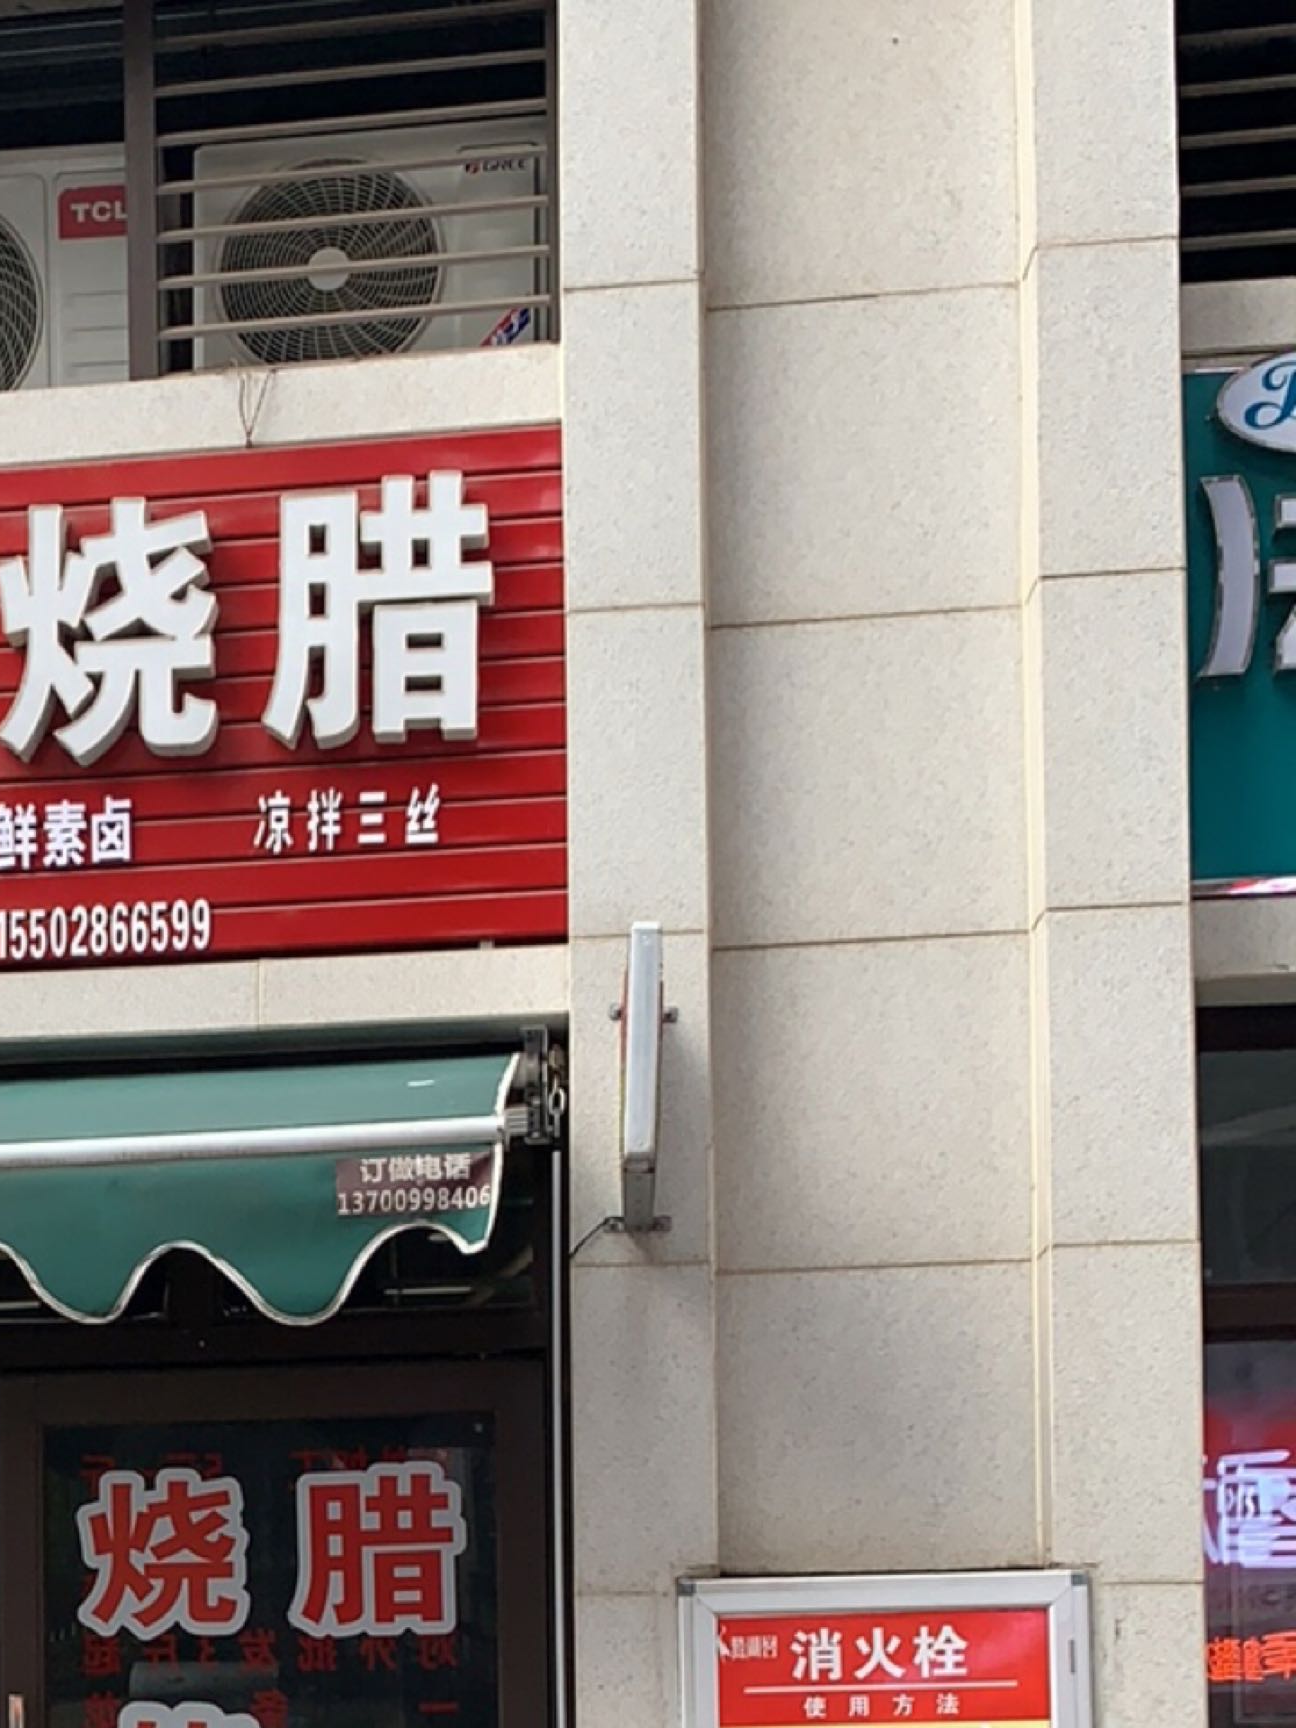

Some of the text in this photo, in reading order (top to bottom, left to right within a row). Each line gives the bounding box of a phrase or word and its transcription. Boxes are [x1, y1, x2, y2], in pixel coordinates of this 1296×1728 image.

[70, 200, 128, 223] TCL
[253, 783, 441, 853] 凉拌三丝
[360, 1153, 472, 1183] 订做电话
[337, 1185, 491, 1216] 13700998406
[88, 1473, 454, 1629] 烧腊
[790, 1625, 970, 1682] 消火栓
[803, 1693, 961, 1718] 使用方法
